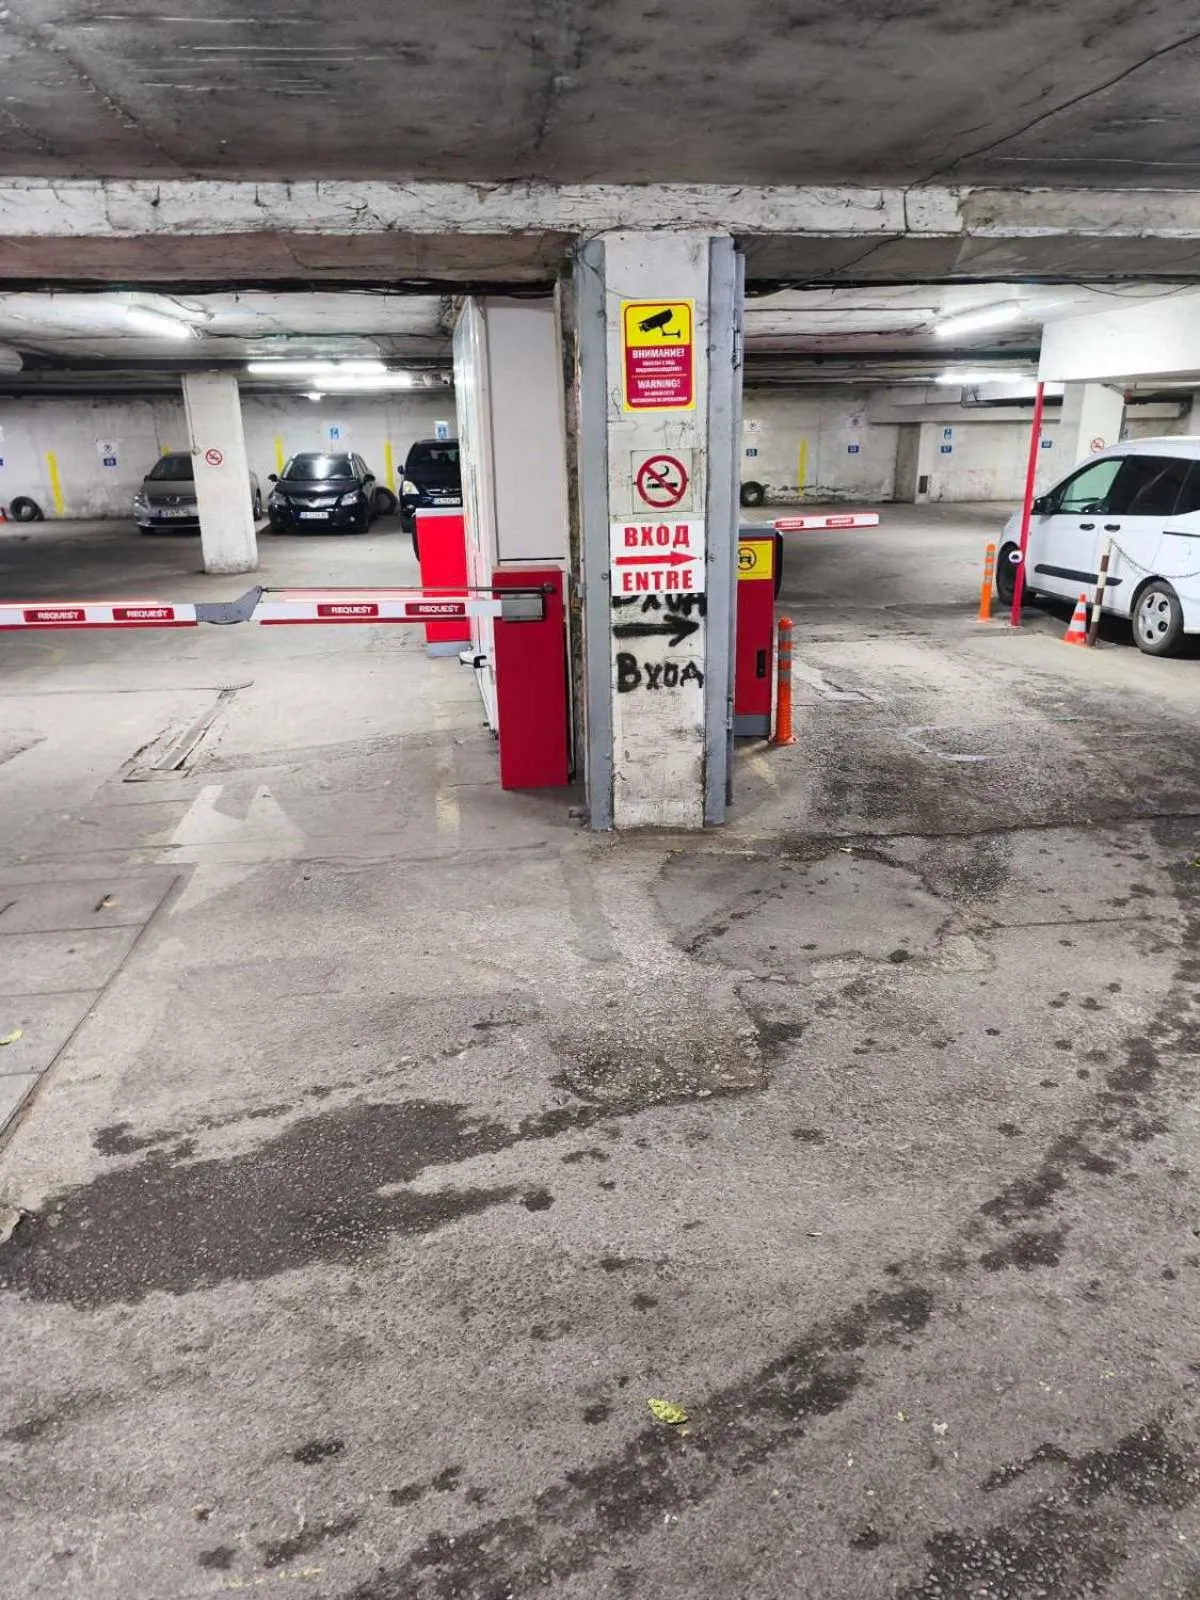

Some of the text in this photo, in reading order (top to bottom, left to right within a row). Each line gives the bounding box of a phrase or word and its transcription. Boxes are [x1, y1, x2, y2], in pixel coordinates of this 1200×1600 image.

[637, 379, 680, 389] WARNING!
[624, 525, 690, 548] ВХОД
[622, 570, 693, 592] ENTRE
[331, 605, 373, 614] REQUEST
[419, 604, 459, 613] REQUEST
[37, 611, 78, 620] REQUEST
[126, 609, 168, 618] REQUEST
